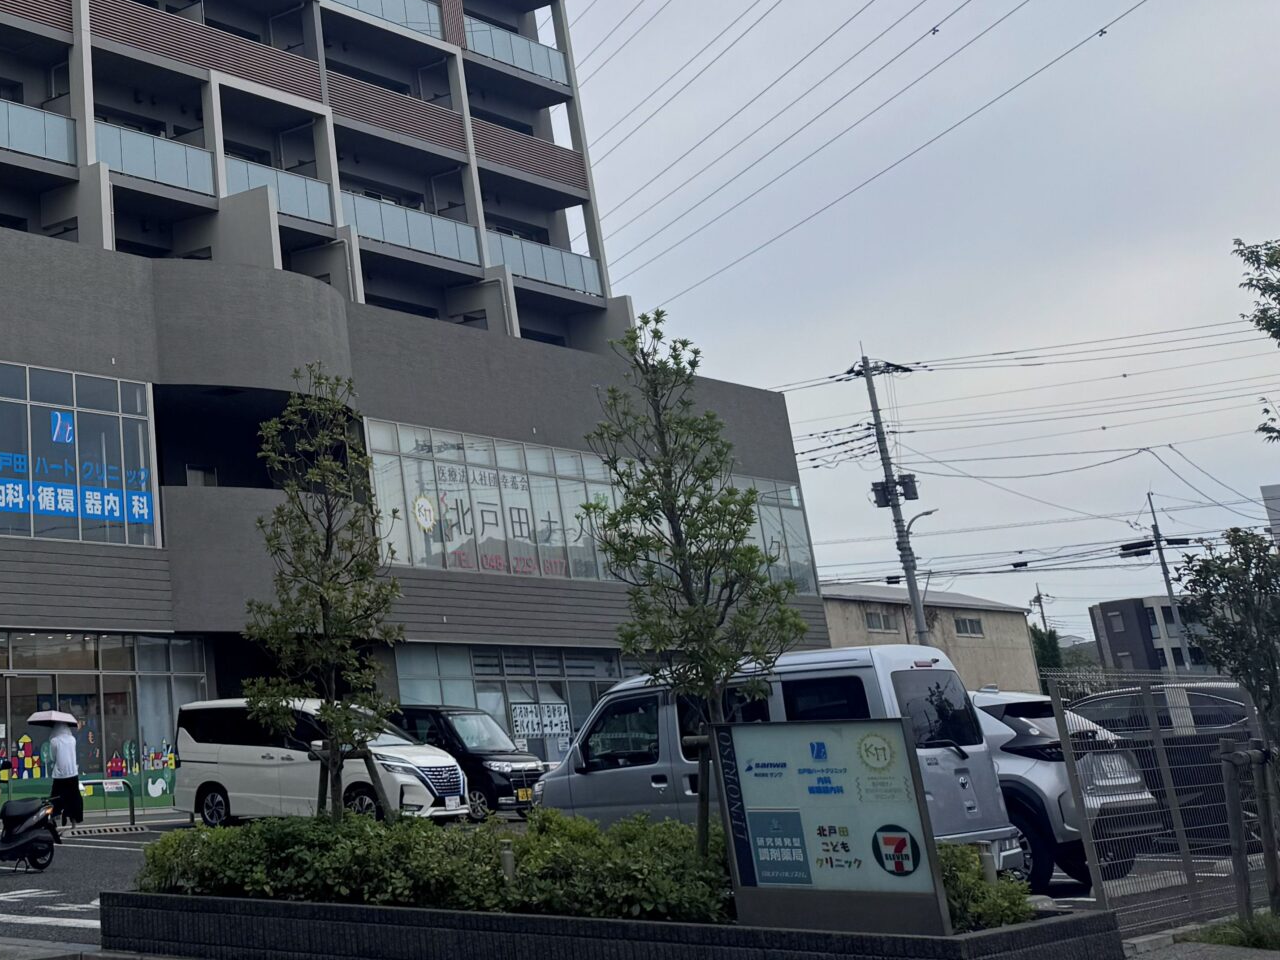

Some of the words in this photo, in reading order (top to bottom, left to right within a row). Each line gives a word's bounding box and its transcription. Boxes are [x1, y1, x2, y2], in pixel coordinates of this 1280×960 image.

[755, 761, 787, 769] sanwa
[817, 825, 849, 837] 北戸田
[822, 842, 850, 853] こども
[883, 836, 907, 872] 7
[816, 856, 862, 869] クリニック
